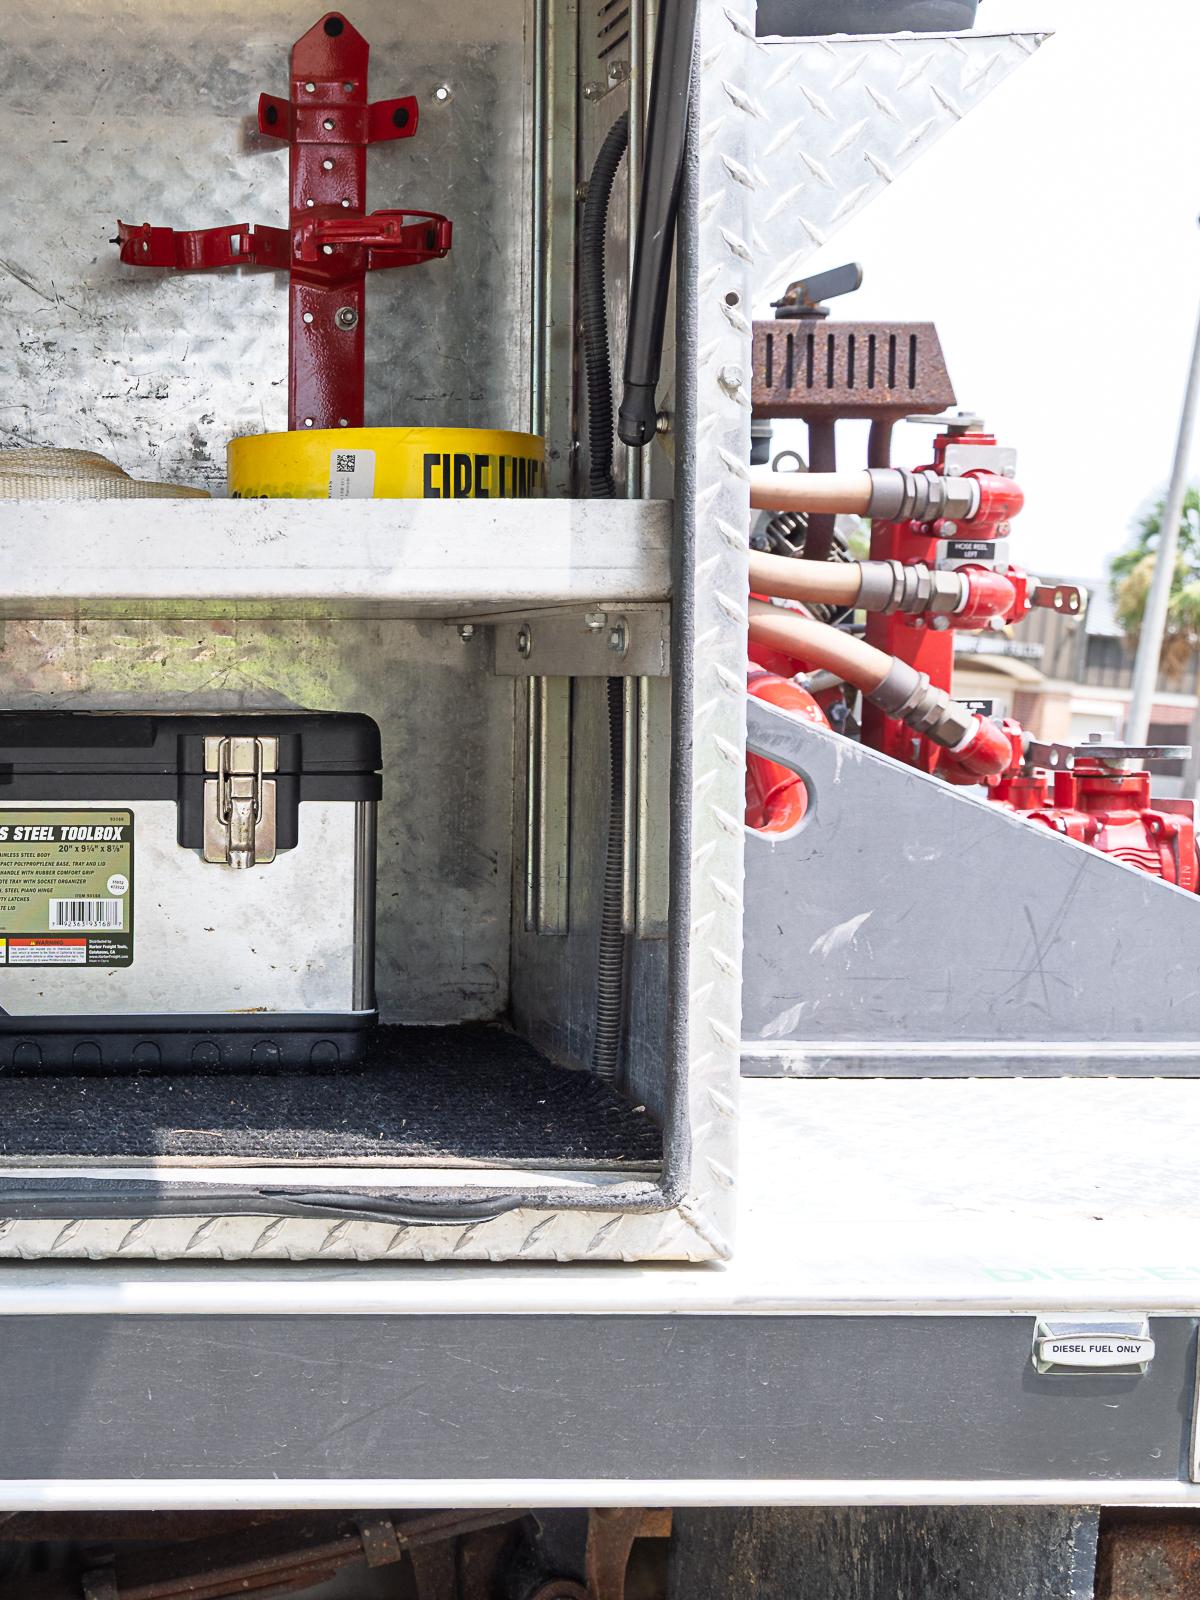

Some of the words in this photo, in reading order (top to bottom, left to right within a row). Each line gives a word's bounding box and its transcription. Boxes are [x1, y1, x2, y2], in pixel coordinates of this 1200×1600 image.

[423, 453, 489, 499] FIRE
[973, 543, 988, 551] REEL
[13, 826, 55, 841] STEEL
[60, 826, 124, 841] TOOLBOX
[58, 845, 73, 853] 20"
[1052, 1345, 1086, 1353] DIESEL
[1089, 1345, 1114, 1353] FUEL
[1116, 1345, 1141, 1353] ONLY
